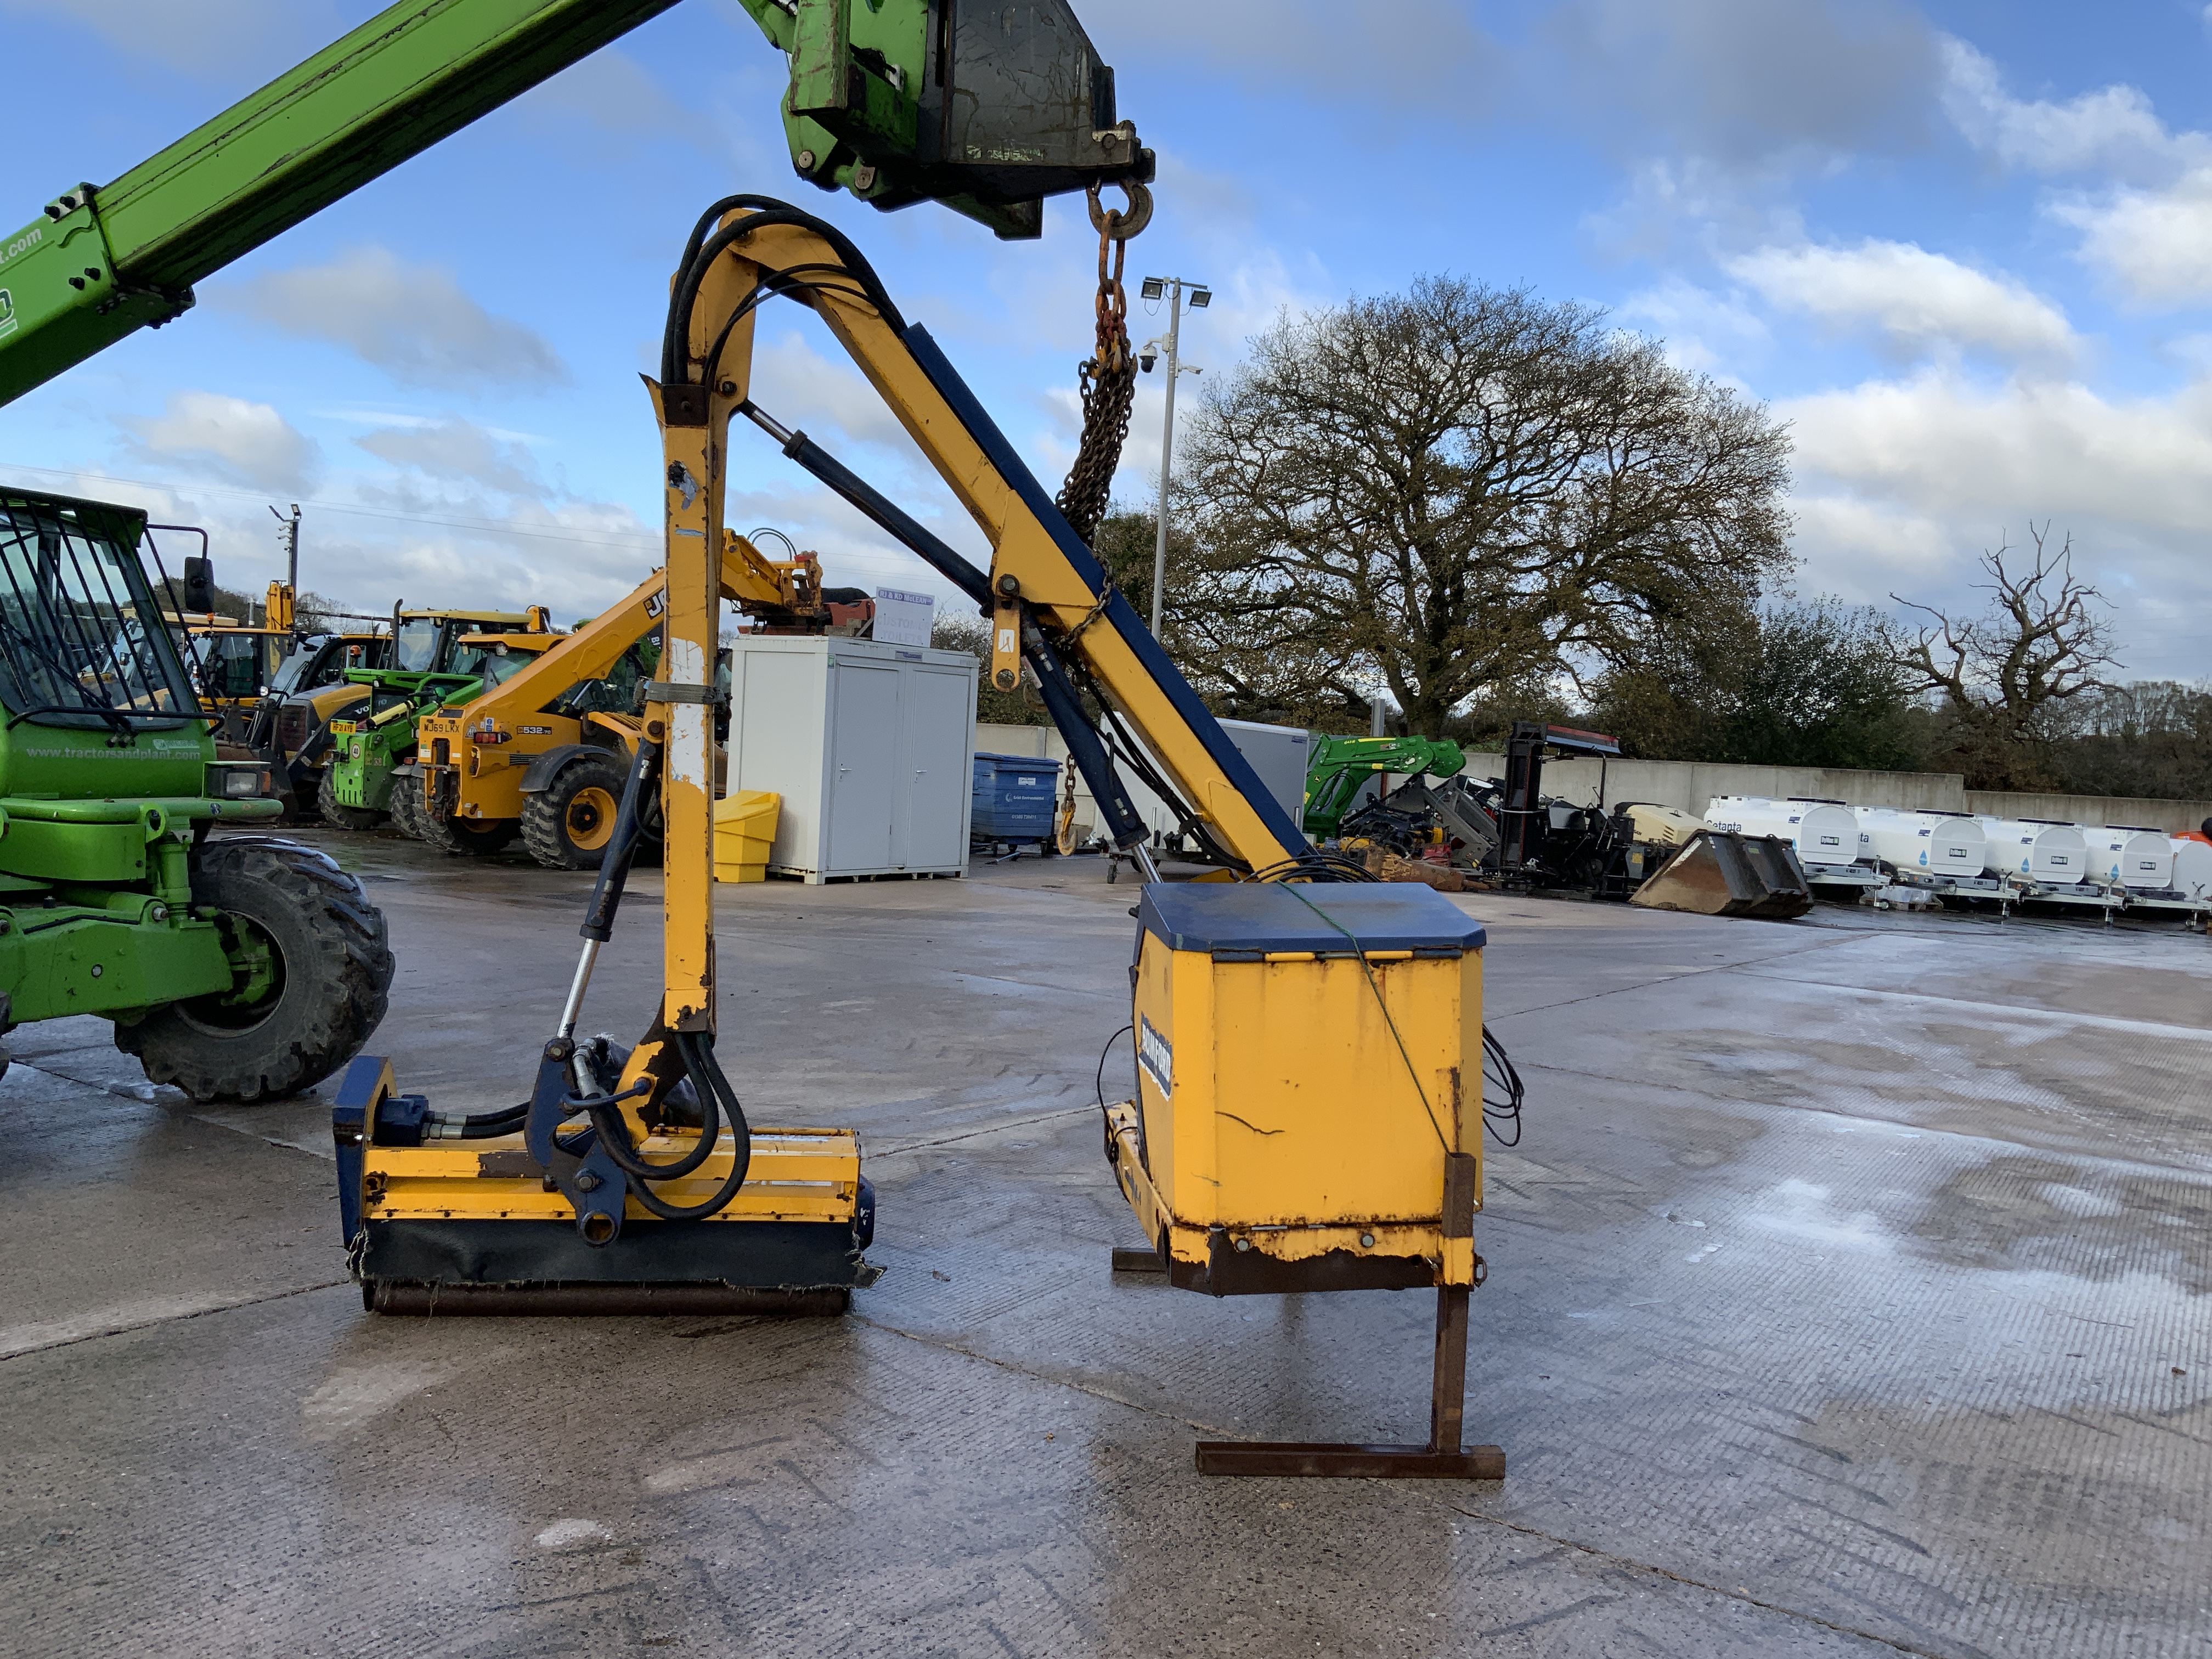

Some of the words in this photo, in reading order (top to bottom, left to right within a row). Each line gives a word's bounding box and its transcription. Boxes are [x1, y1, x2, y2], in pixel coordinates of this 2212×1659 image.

[904, 595, 927, 604] McLEAN
[883, 630, 923, 644] TOILETS
[424, 723, 444, 732] WJ69
[445, 724, 460, 733] LKX
[26, 747, 201, 760] www.tractorsandplant.com
